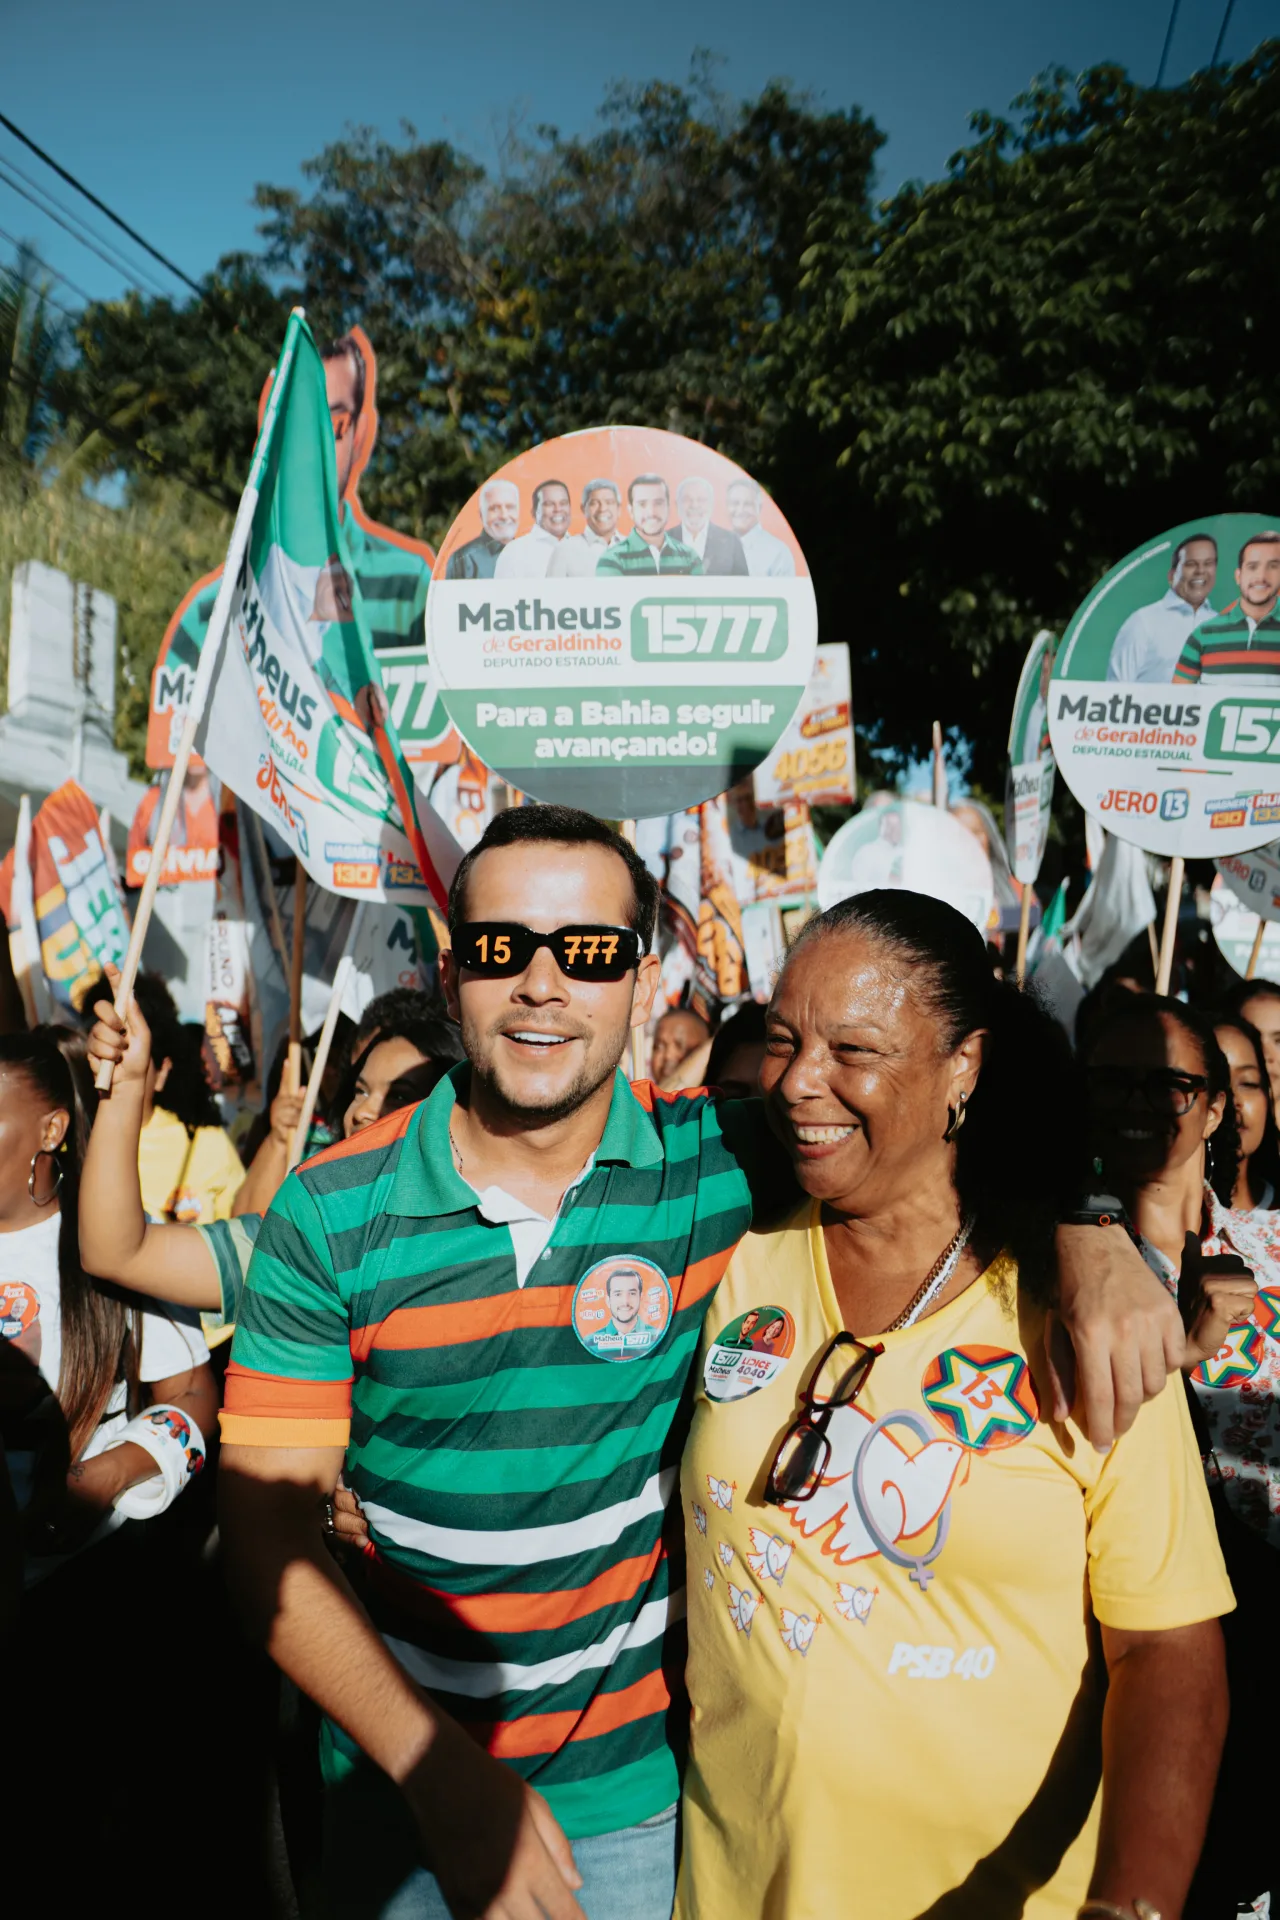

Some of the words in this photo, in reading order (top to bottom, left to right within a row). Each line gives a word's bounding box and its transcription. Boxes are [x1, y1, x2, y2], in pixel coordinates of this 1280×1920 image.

[458, 598, 622, 632] Matheus
[641, 604, 777, 654] 15777
[482, 635, 505, 653] de
[508, 632, 622, 652] Geraldinho
[483, 656, 553, 668] DEPUTADO
[555, 655, 621, 668] ESTADUAL
[476, 702, 547, 727] Para
[554, 706, 574, 727] a
[580, 700, 669, 725] Bahia
[676, 699, 775, 729] seguir
[1056, 694, 1202, 727] Matheus
[535, 730, 717, 761] avançando!
[1074, 726, 1095, 742] de
[1096, 726, 1198, 747] Geraldinho
[1072, 744, 1133, 759] DEPUTADO
[1134, 748, 1193, 761] ESTADUAL
[1100, 789, 1158, 815] JERO
[1164, 791, 1188, 818] 13
[1213, 811, 1242, 826] 130
[133, 847, 221, 873] OIVIA
[335, 864, 373, 886] 130
[475, 934, 511, 964] 15
[564, 935, 619, 964] 777
[594, 1334, 622, 1343] Matheus
[736, 1365, 766, 1379] 4040
[961, 1371, 1004, 1410] 13
[888, 1642, 954, 1680] PSB
[953, 1646, 996, 1680] 40
